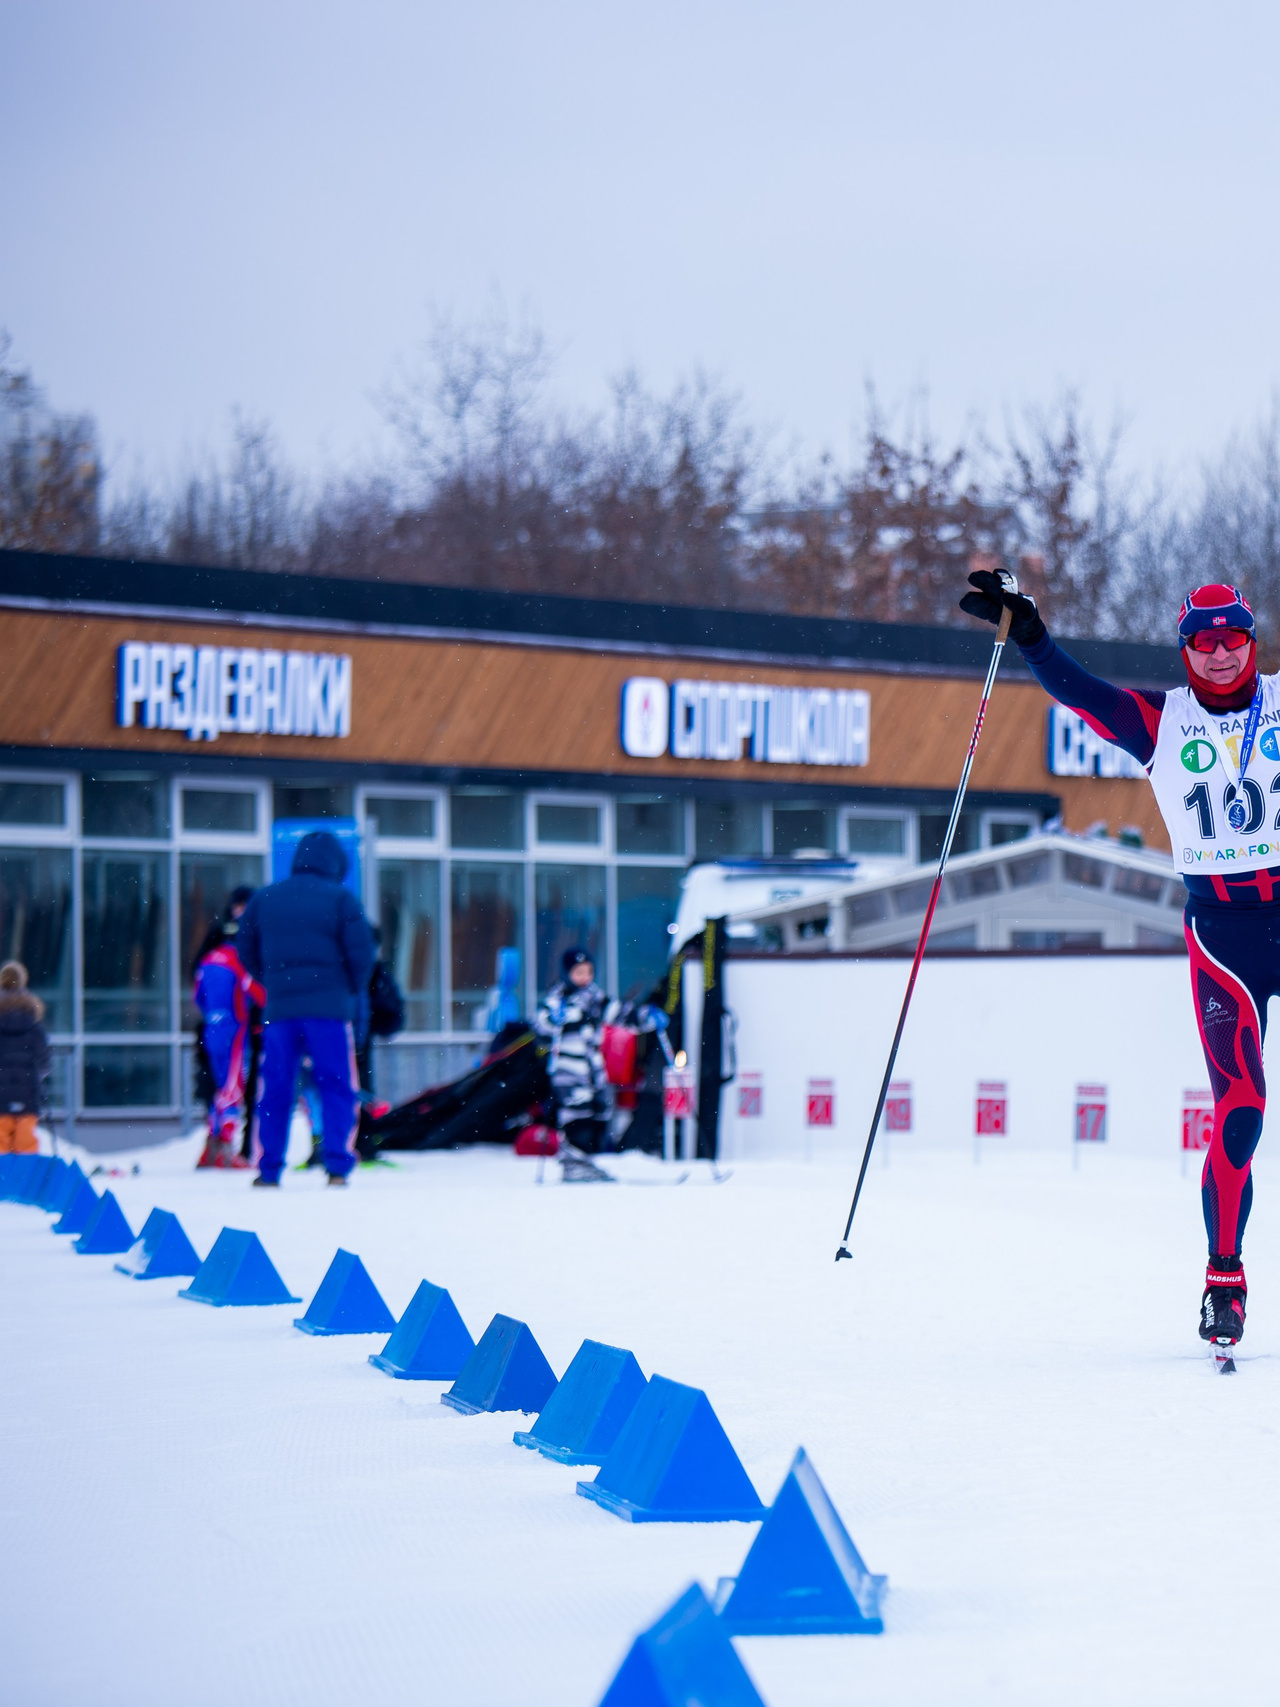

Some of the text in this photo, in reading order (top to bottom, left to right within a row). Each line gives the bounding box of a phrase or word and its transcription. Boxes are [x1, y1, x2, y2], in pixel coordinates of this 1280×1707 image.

[117, 641, 352, 741] РАЗДЕВАЛКИ
[670, 678, 871, 767] СПОРТШКОЛА
[1077, 1104, 1106, 1140] 17
[1184, 1109, 1214, 1149] 16
[1207, 1274, 1242, 1282] MADSHUS
